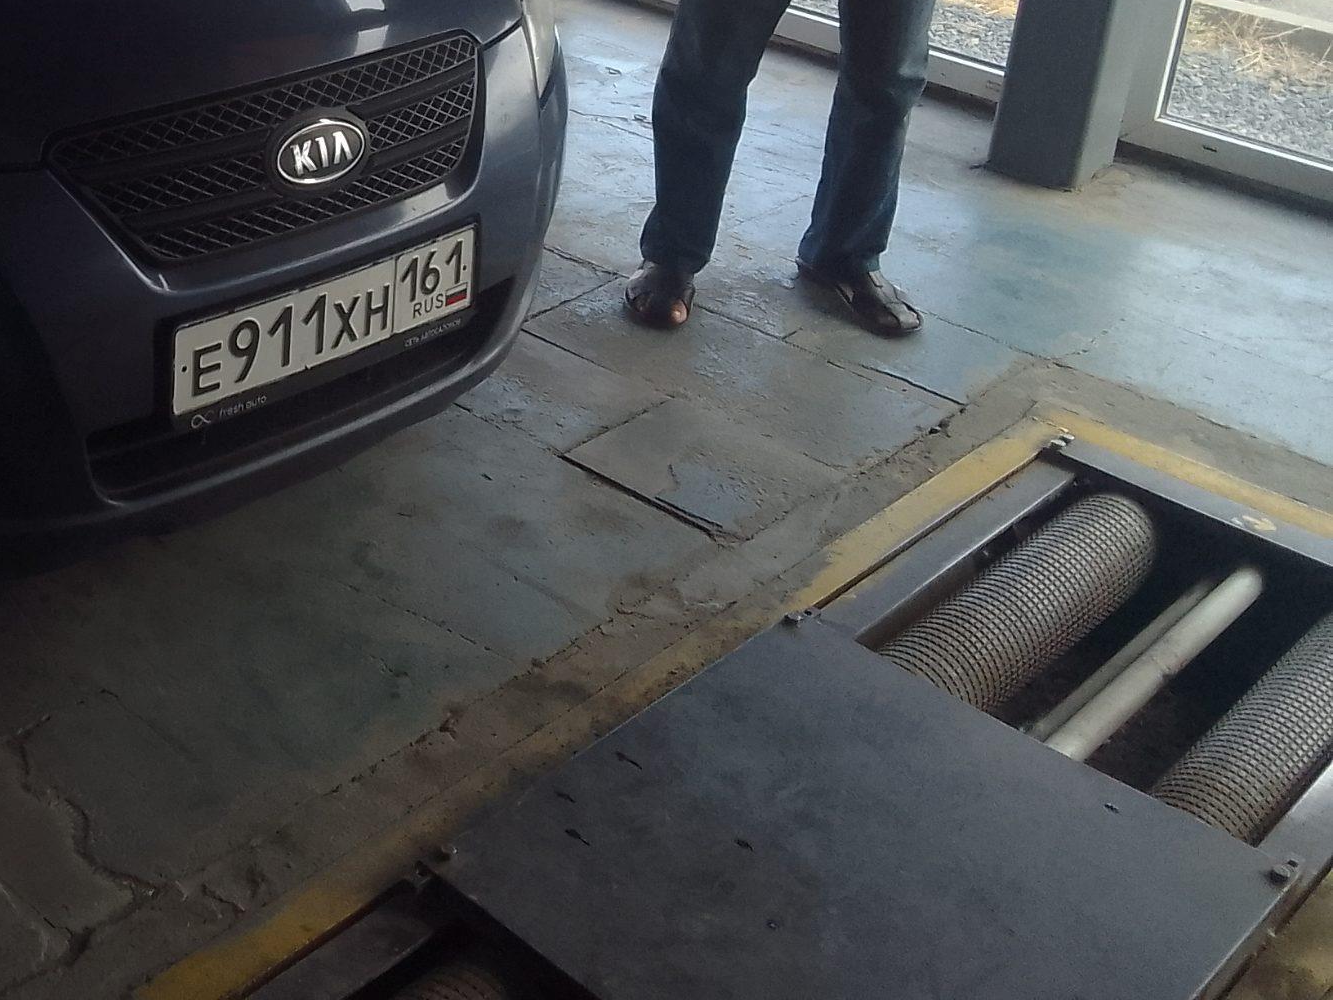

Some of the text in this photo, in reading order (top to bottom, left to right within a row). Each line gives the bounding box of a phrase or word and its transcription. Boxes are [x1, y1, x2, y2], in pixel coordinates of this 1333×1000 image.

[290, 131, 354, 176] KIA
[399, 240, 464, 302] 161
[412, 293, 444, 319] RUS
